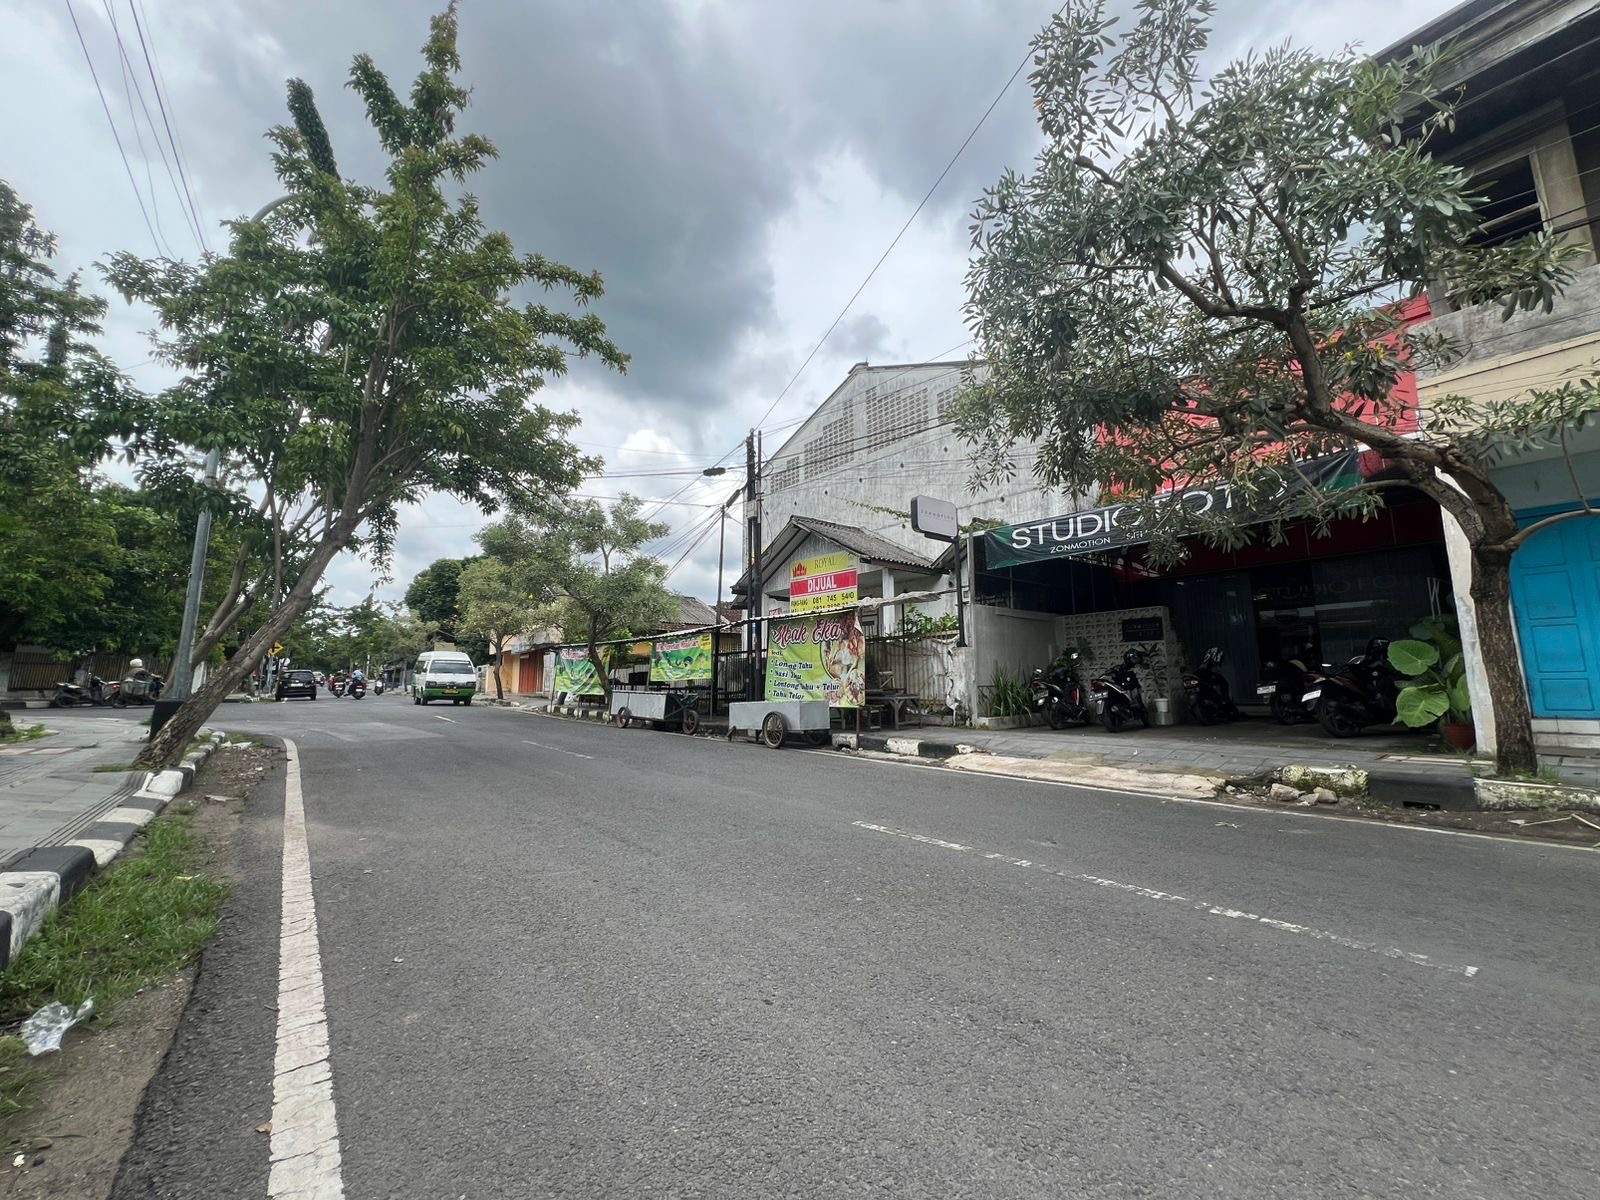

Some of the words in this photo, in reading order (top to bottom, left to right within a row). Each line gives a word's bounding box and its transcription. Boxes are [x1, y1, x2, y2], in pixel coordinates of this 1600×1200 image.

[1012, 505, 1144, 549] STUDIO
[1050, 537, 1111, 553] ZONMOTION
[814, 556, 836, 569] ROYAL
[807, 575, 837, 593] DIJUAL
[812, 619, 842, 644] Eka
